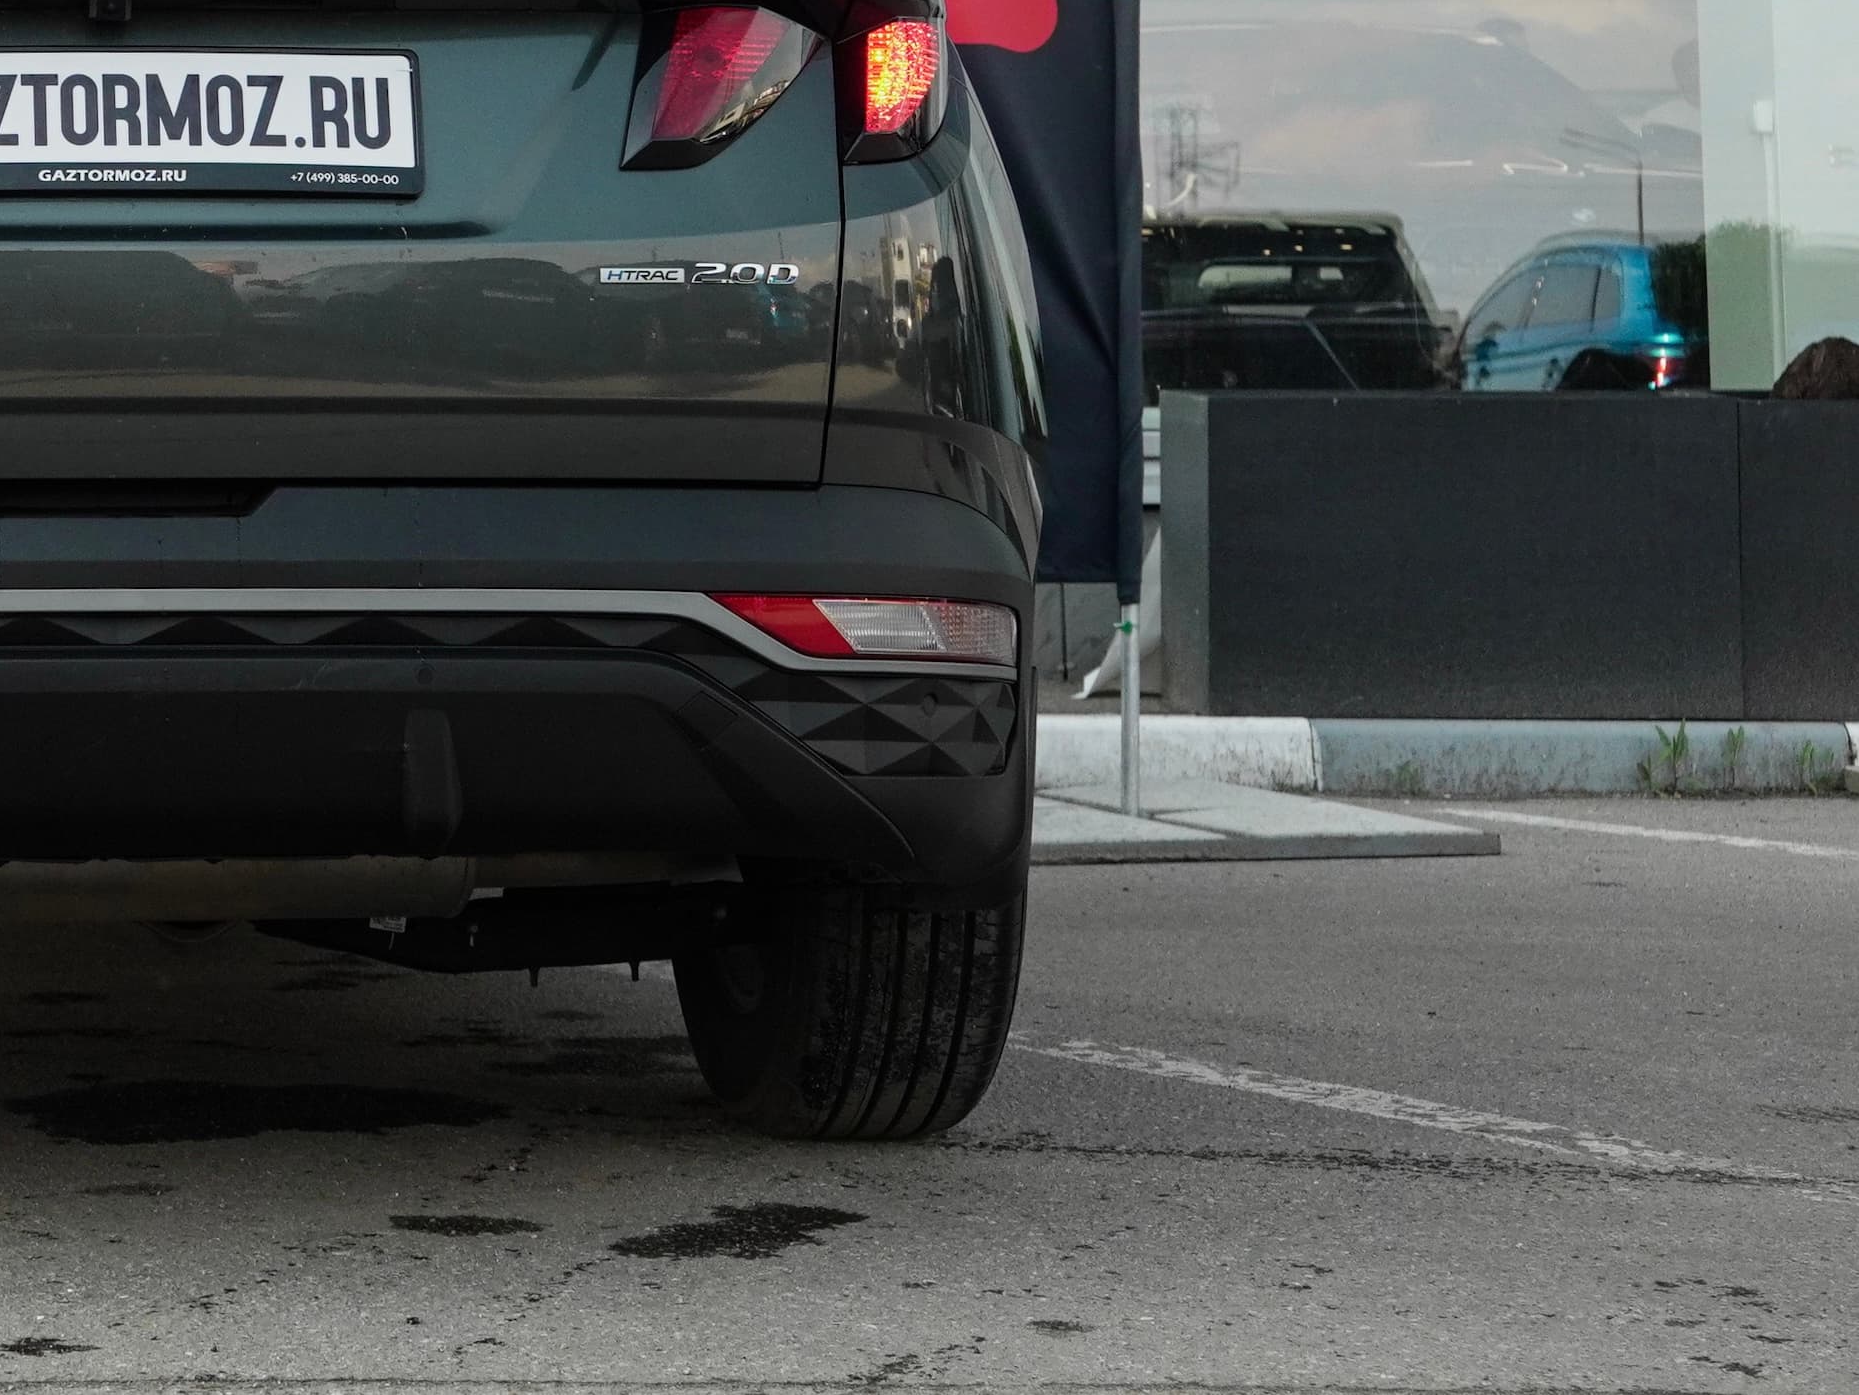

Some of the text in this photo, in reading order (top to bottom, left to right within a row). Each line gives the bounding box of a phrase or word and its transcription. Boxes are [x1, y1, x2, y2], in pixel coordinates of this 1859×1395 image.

[38, 168, 187, 183] GAZTORMOZ.RU
[290, 172, 399, 185] +7 (499) 385-00-00
[607, 269, 678, 281] HTRAC
